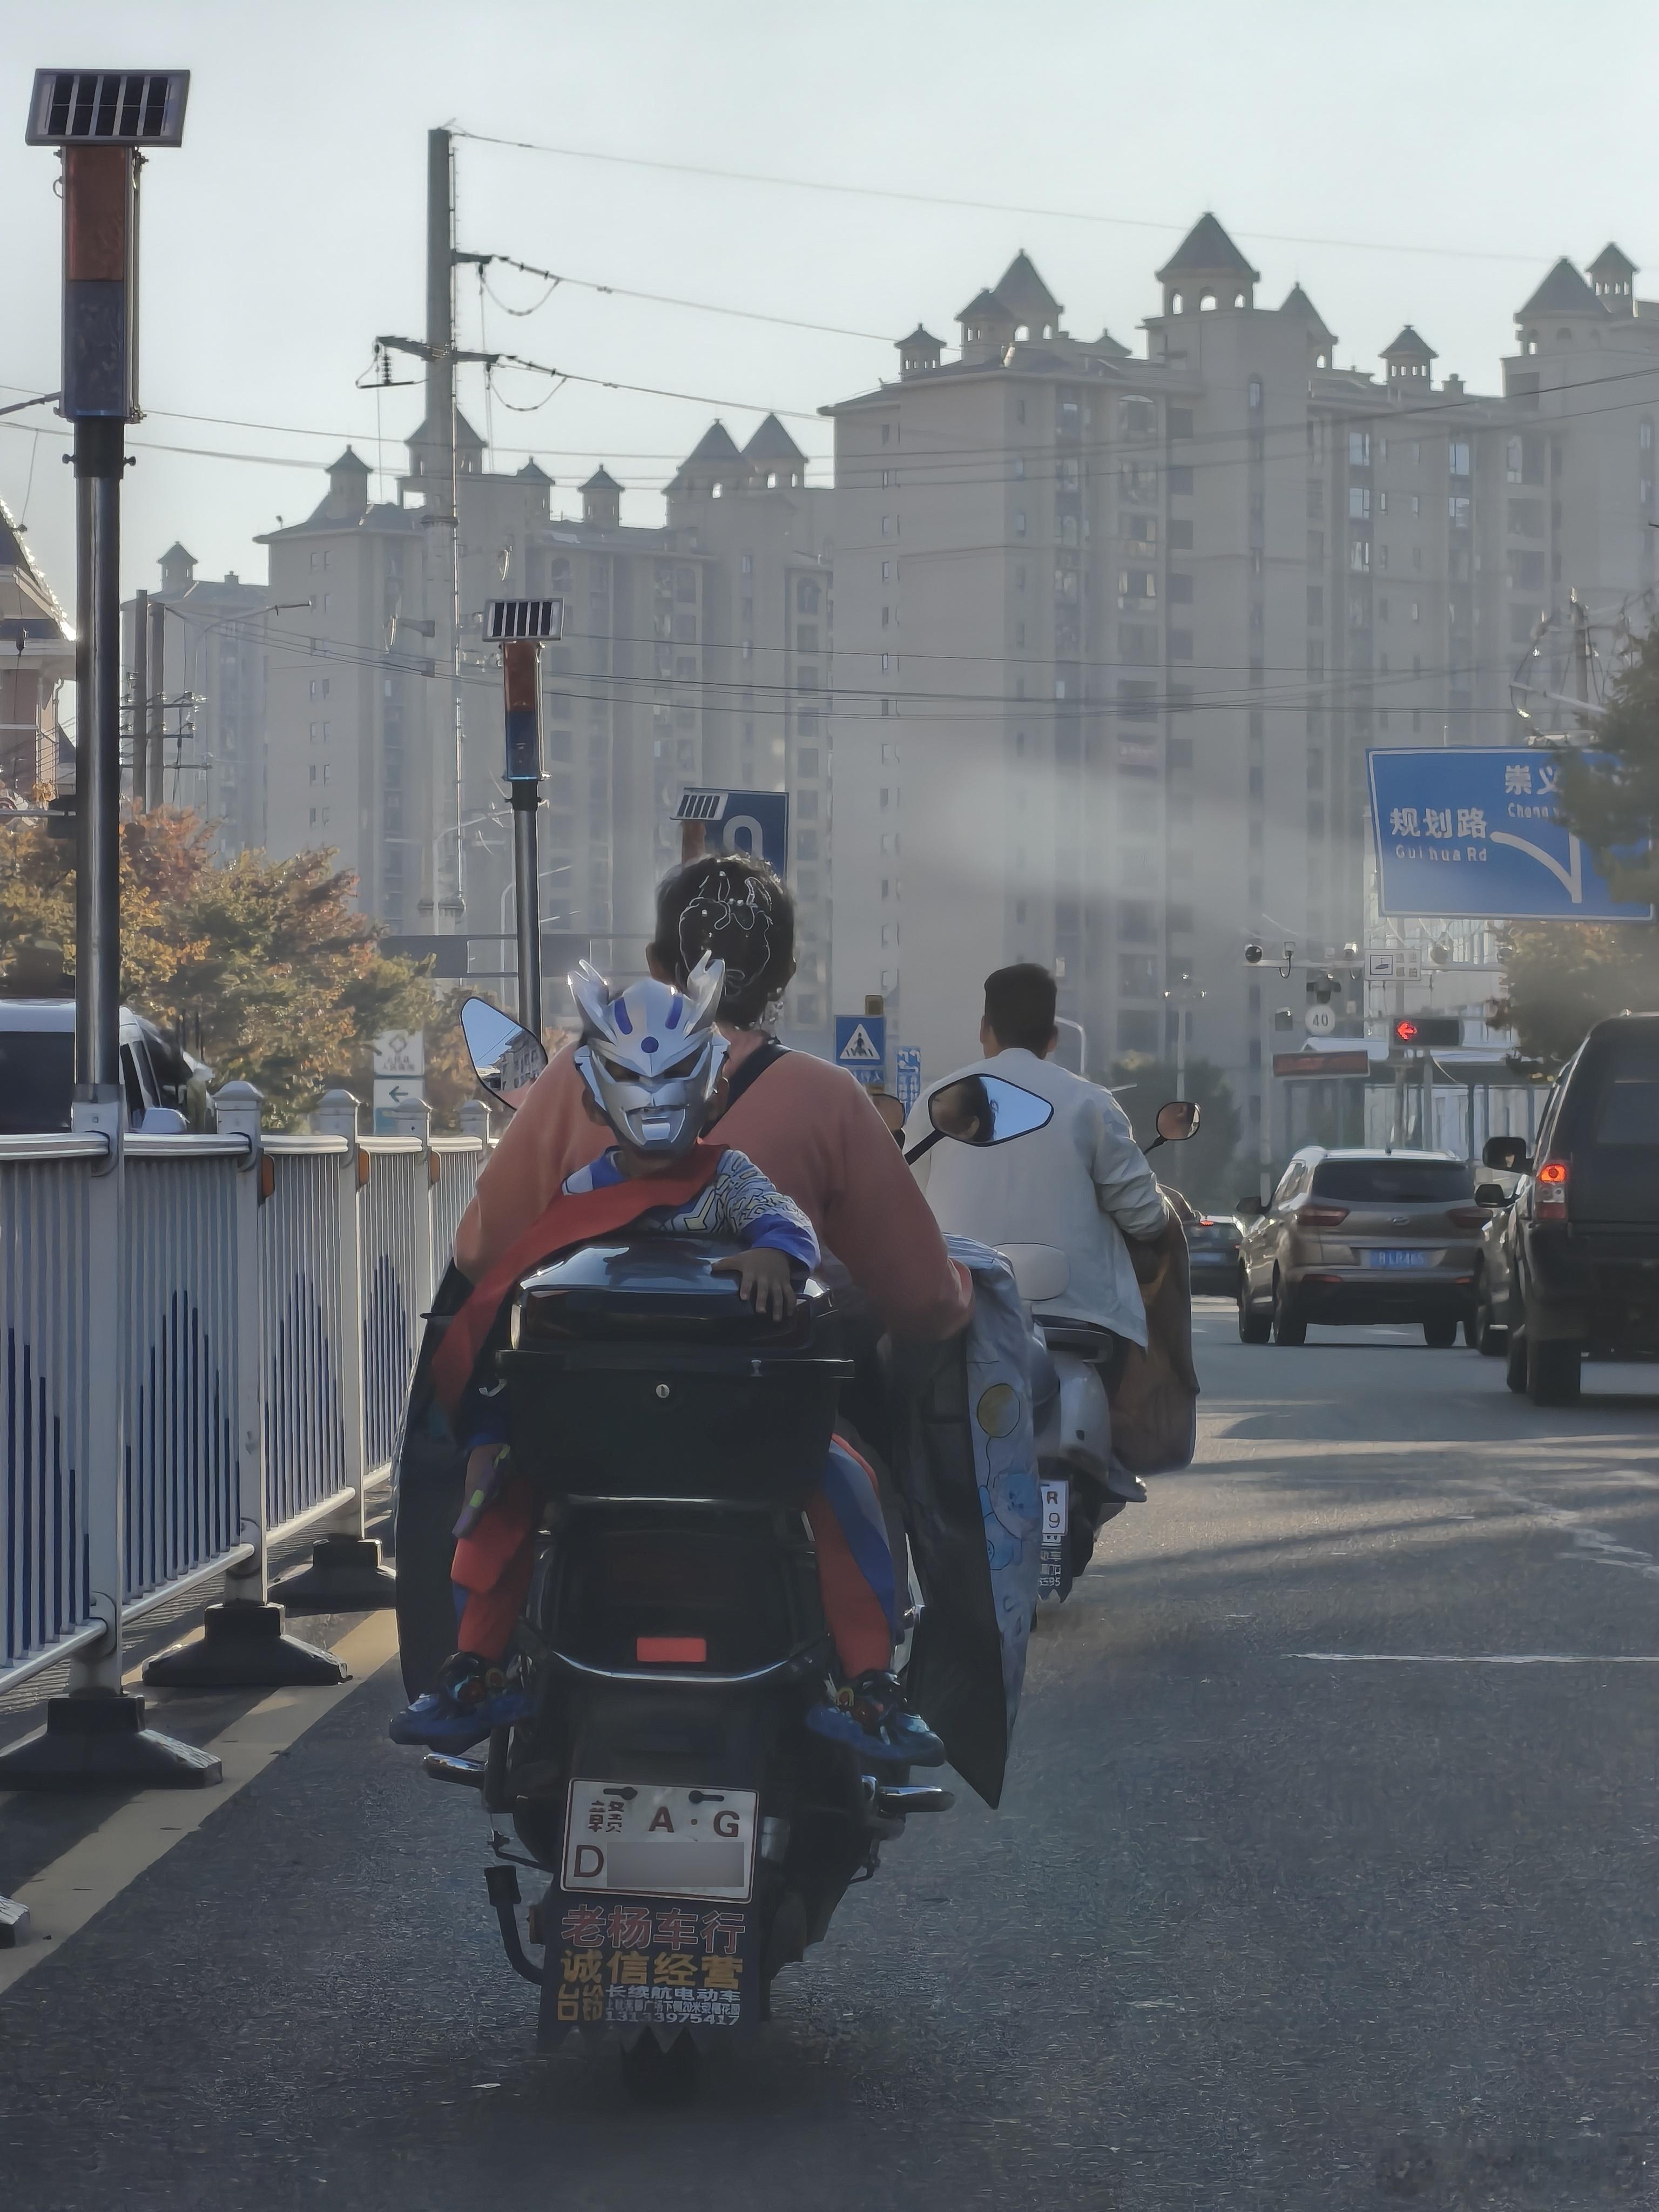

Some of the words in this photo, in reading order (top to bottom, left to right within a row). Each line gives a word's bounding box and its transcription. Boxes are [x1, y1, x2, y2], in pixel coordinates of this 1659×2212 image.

[1390, 807, 1487, 838] 规划路
[1467, 846, 1487, 861] Rd
[1312, 1013, 1328, 1027] 40
[1048, 1513, 1060, 1528] 9
[561, 1904, 746, 1954] 老杨车行
[560, 1949, 743, 1990] 诚信经营
[605, 1984, 741, 2002] 长续航电动车
